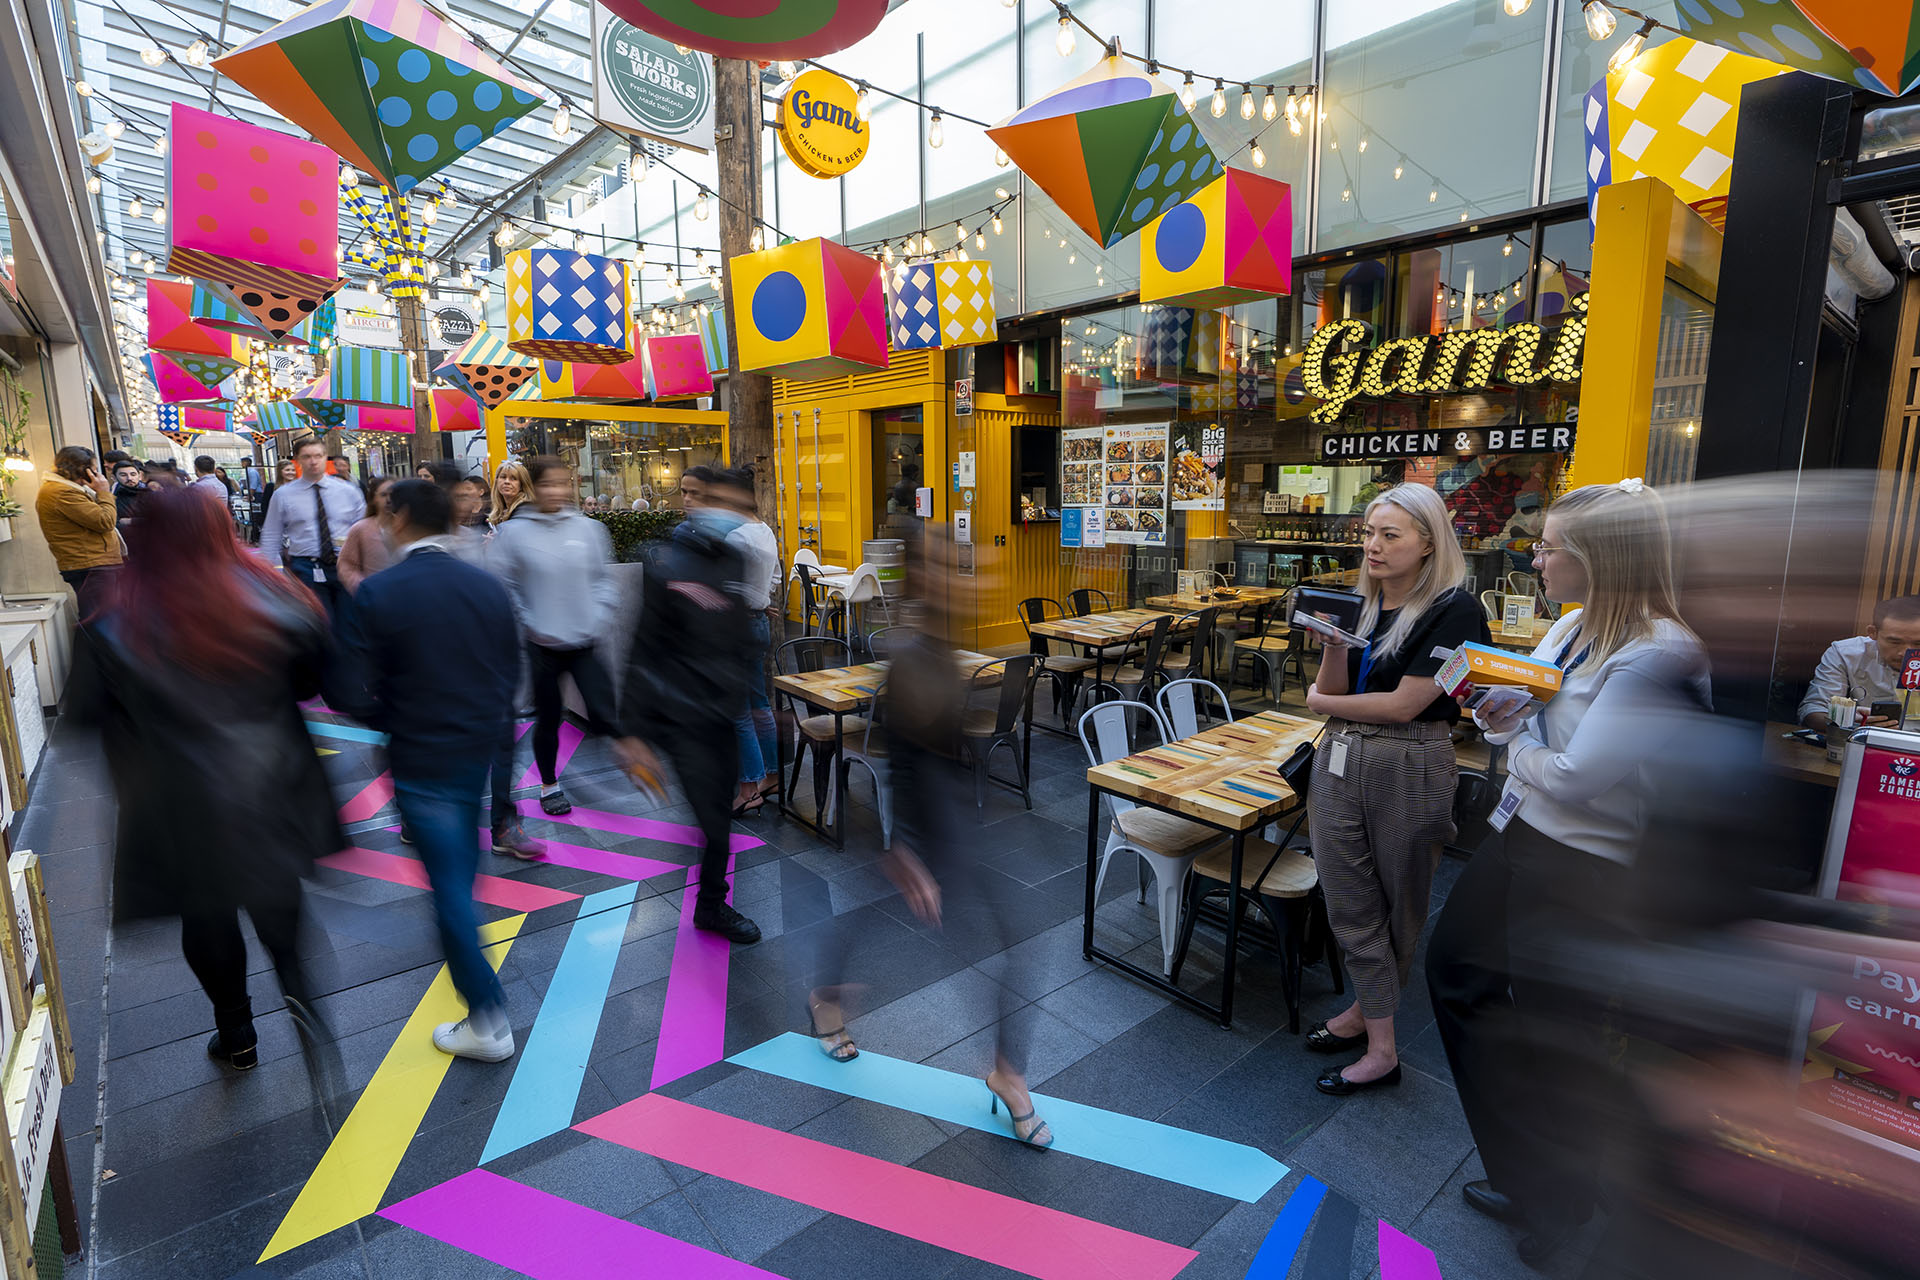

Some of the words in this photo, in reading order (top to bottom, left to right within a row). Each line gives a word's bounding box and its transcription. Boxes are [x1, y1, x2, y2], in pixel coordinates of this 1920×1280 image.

[615, 39, 680, 79] SALAD
[630, 59, 697, 100] WORKS
[629, 82, 648, 96] Fresh
[648, 90, 685, 110] Ingredients
[638, 96, 656, 109] Made
[656, 103, 676, 118] Daily
[798, 133, 834, 164] CHICKEN
[836, 157, 843, 165] &
[844, 146, 864, 164] BEER
[1301, 289, 1590, 424] Gami
[1201, 445, 1225, 457] BIG
[1324, 432, 1440, 457] CHICKEN
[1454, 431, 1471, 451] &
[1488, 426, 1570, 450] BEER
[1852, 955, 1920, 1004] Pay
[1845, 995, 1920, 1031] earn
[27, 1086, 45, 1165] Fresh
[40, 1040, 57, 1104] Daily
[1852, 1079, 1879, 1094] Google
[1878, 1090, 1896, 1100] Play
[1886, 1105, 1904, 1116] meal
[1903, 1112, 1920, 1122] with
